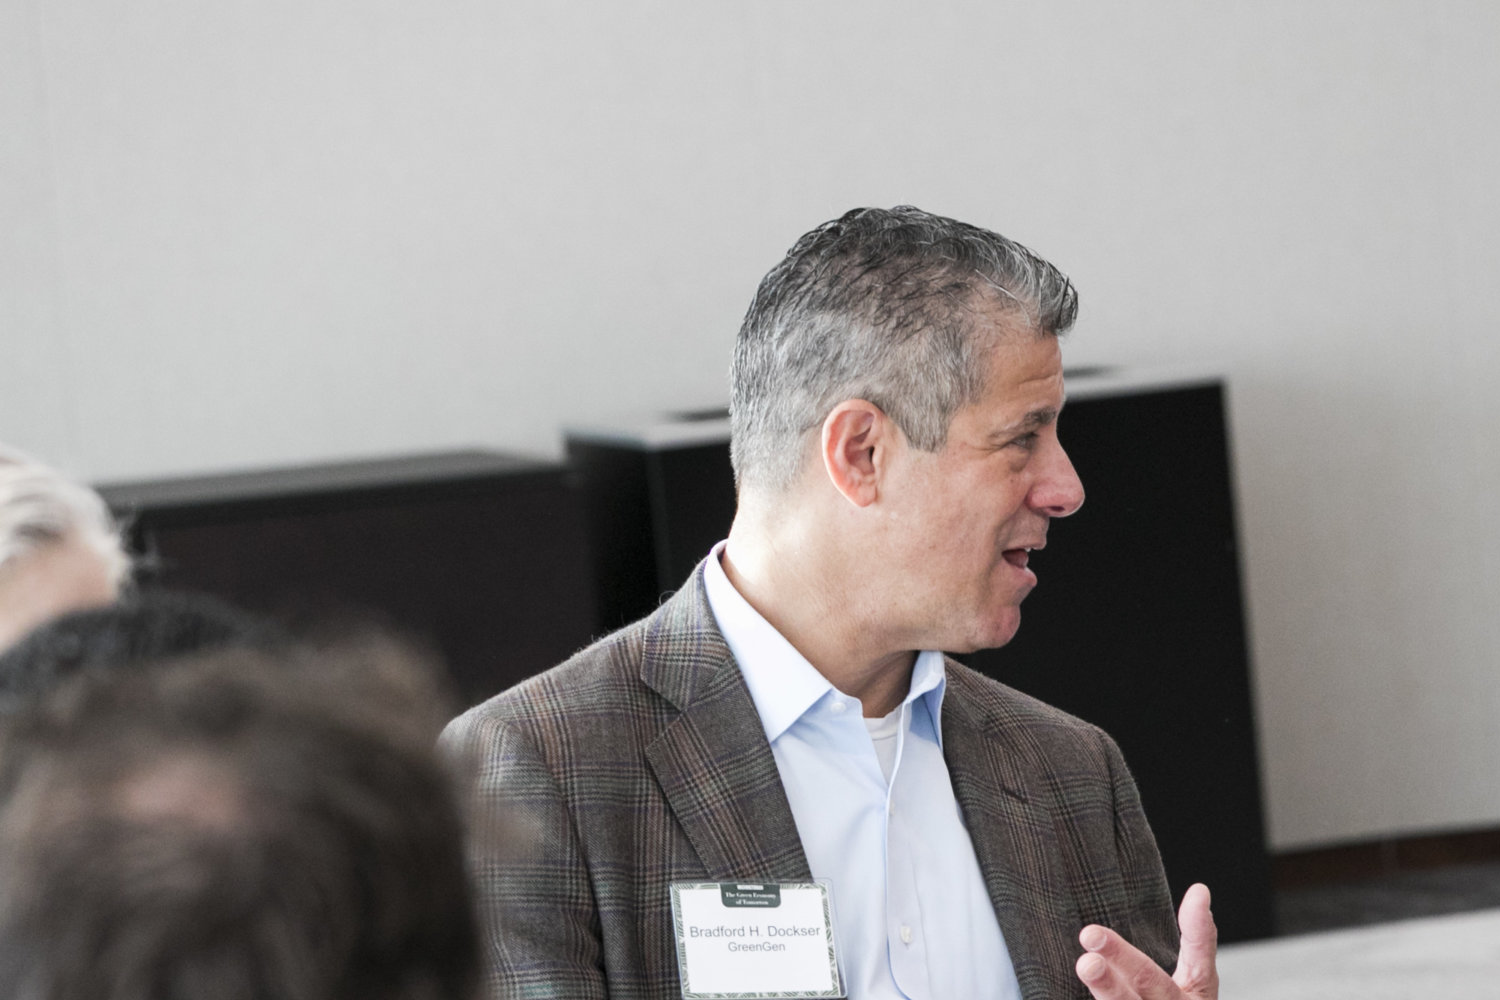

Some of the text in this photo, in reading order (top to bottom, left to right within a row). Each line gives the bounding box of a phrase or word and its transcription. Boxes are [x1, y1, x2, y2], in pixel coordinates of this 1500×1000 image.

[689, 925, 821, 938] Bradford H. Dockser
[727, 941, 786, 952] GreenGen
